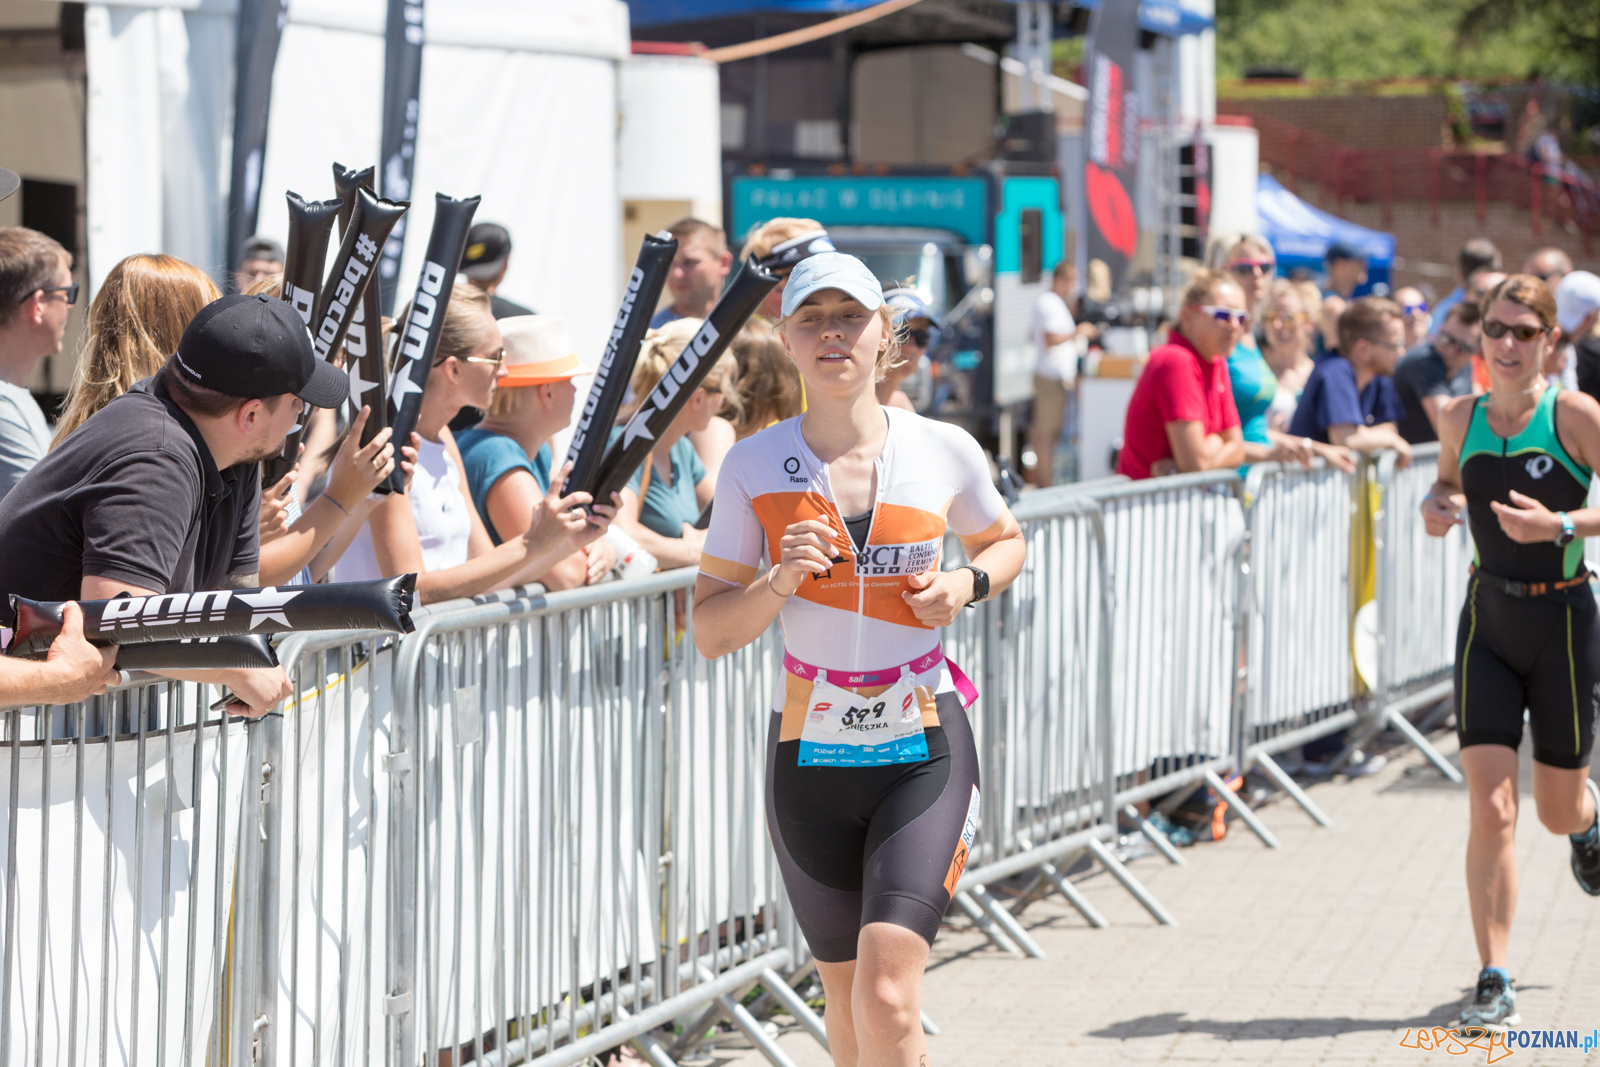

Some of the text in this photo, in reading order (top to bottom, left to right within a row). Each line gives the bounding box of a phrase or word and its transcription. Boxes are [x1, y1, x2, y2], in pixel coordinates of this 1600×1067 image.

[910, 542, 935, 553] BALTIC
[848, 674, 879, 685] sailfish
[841, 701, 886, 726] 599
